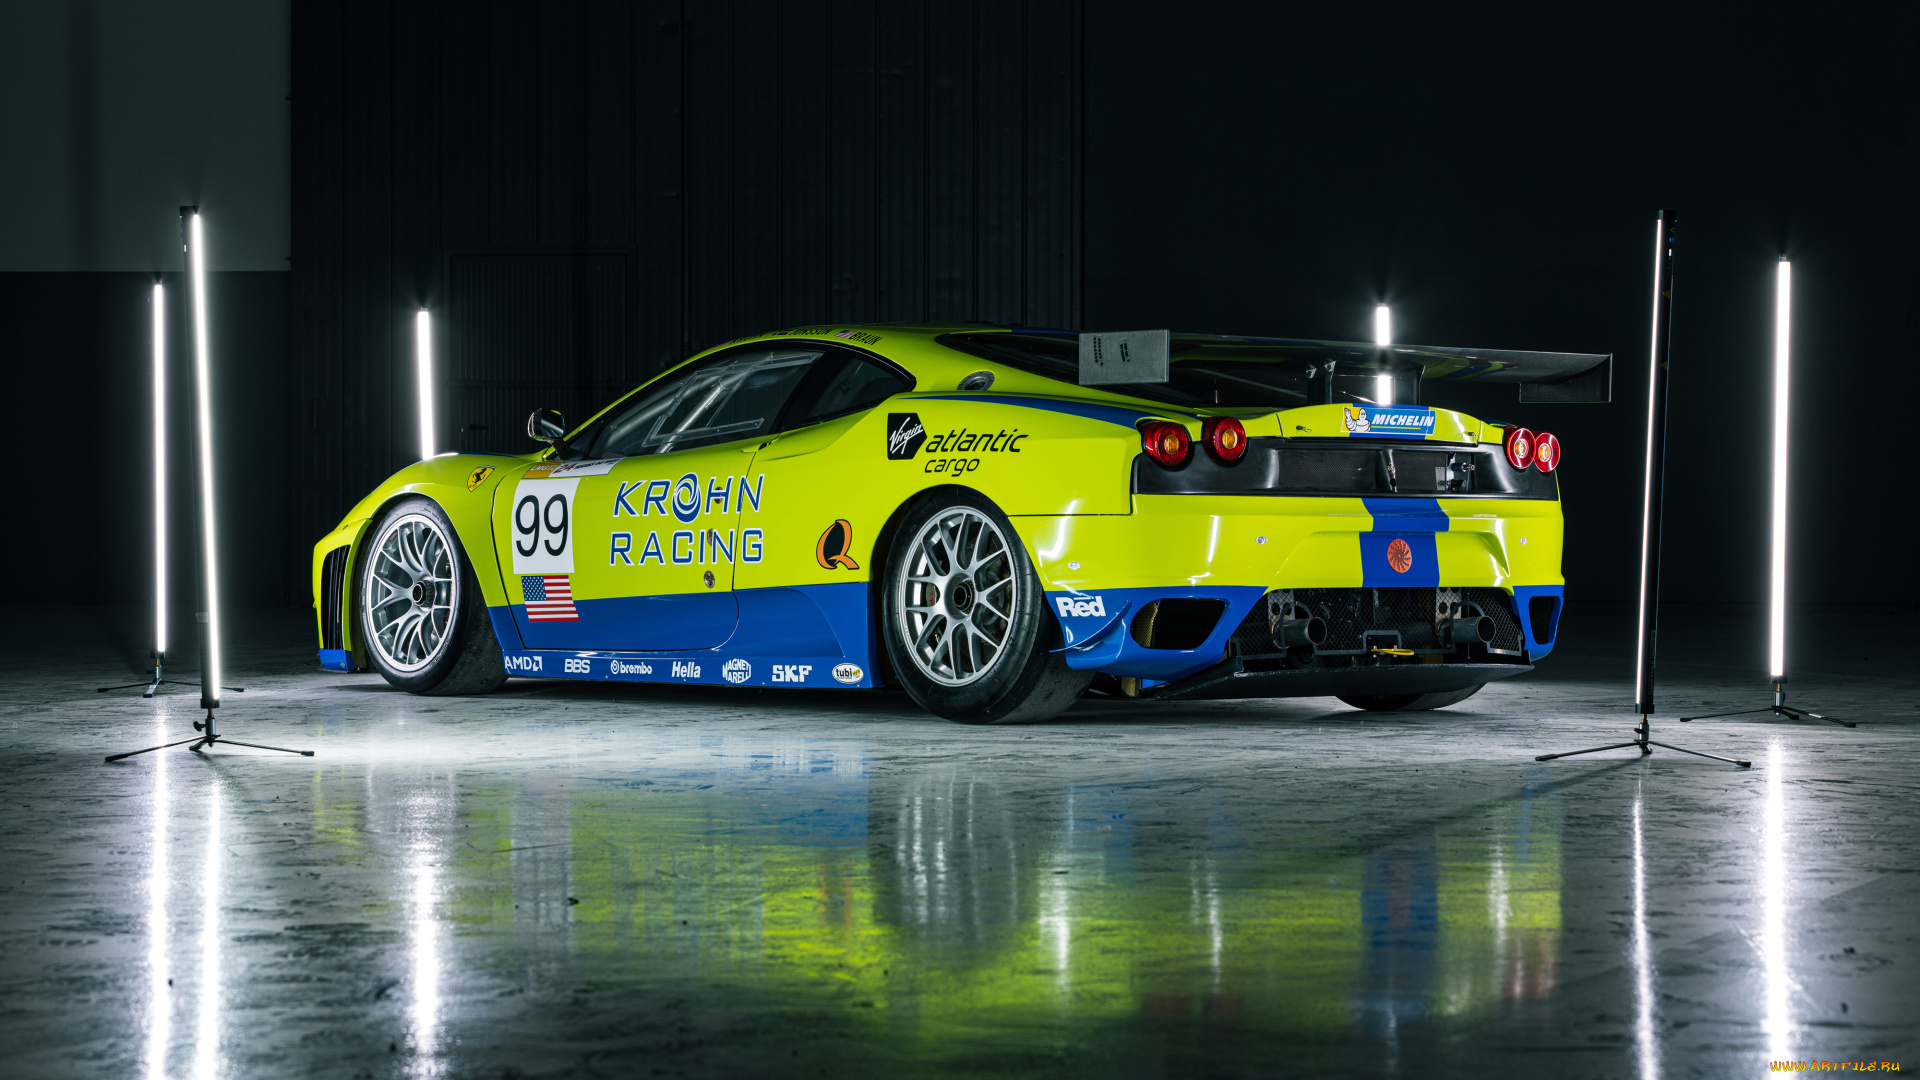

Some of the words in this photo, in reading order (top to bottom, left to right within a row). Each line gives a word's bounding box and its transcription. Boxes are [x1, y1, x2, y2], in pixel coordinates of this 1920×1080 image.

[849, 331, 883, 345] BRAUN
[1371, 414, 1434, 427] MICHELIN
[889, 417, 923, 455] Virgin
[925, 428, 1028, 453] atlantic
[924, 457, 979, 477] cargo
[612, 472, 765, 524] KROHN
[515, 494, 569, 558] 99
[609, 528, 764, 566] RACING
[816, 519, 860, 570] Q
[504, 656, 533, 670] AMD
[564, 658, 590, 674] BBS
[619, 661, 653, 675] brembo
[671, 661, 701, 678] Hella
[835, 667, 852, 678] tubi
[771, 664, 812, 683] SKF
